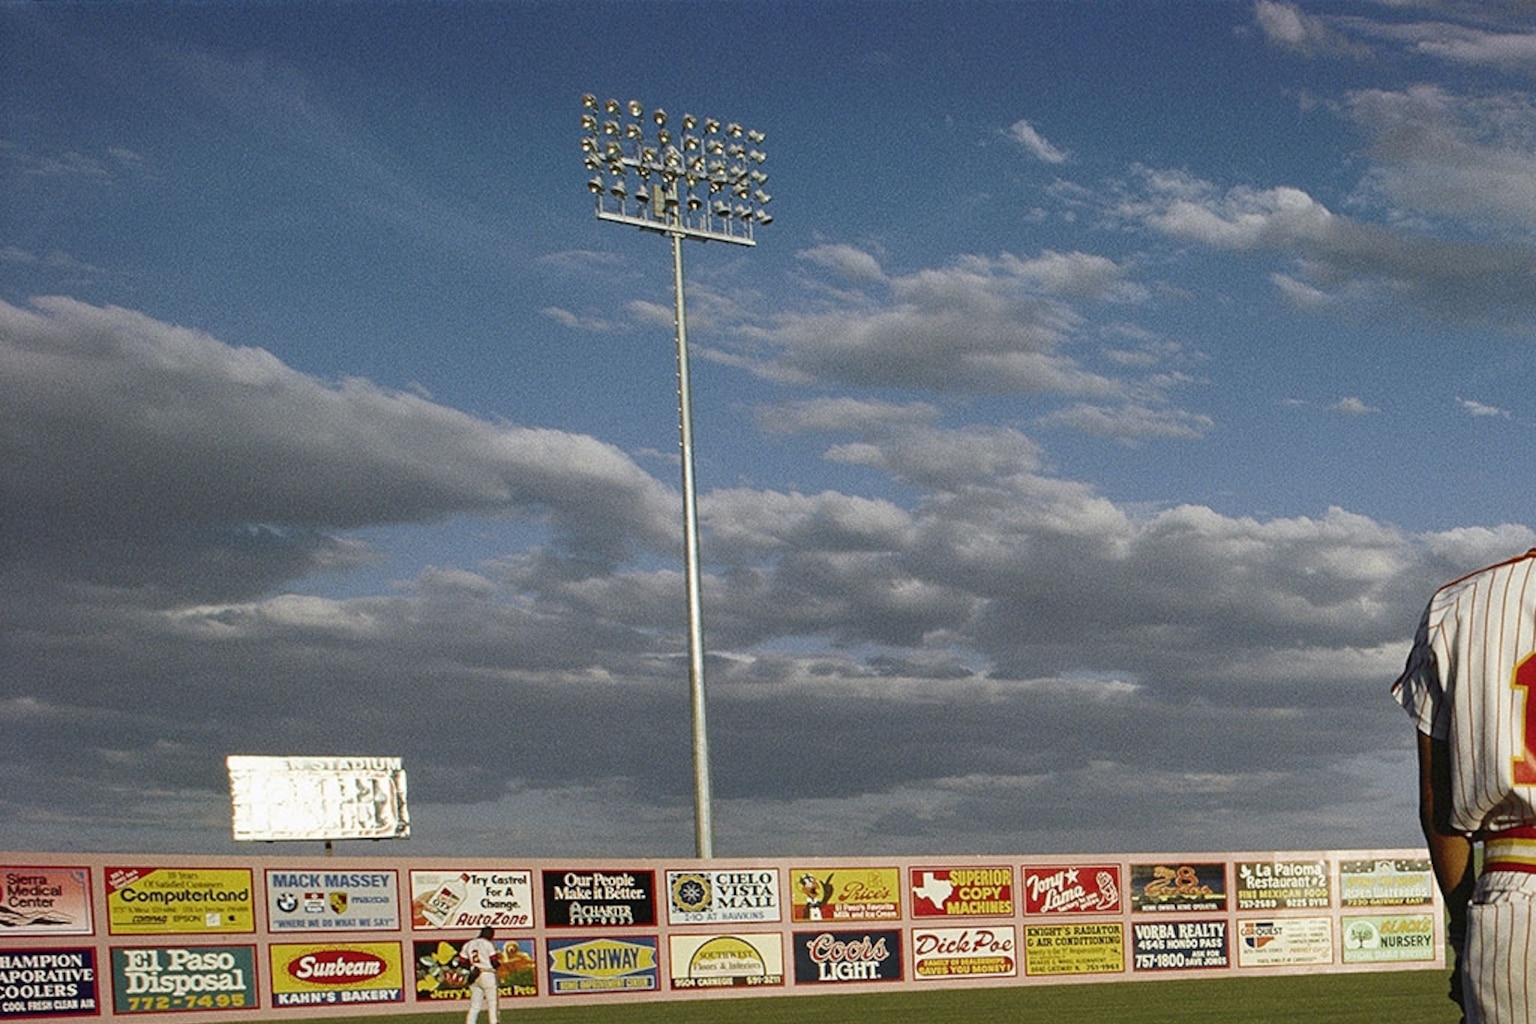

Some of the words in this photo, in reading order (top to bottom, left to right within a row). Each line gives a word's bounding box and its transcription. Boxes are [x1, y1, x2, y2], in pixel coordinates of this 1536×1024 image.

[311, 759, 400, 771] STADIUM
[1255, 864, 1272, 877] La
[1274, 863, 1323, 876] Paloma
[6, 873, 47, 885] Sierra
[272, 874, 322, 888] MACK
[324, 874, 390, 888] MASSEY
[471, 874, 488, 887] Try
[491, 875, 527, 885] Castrol
[563, 872, 593, 888] Our
[593, 872, 636, 890] People
[715, 873, 772, 886] CIELO
[949, 869, 1012, 887] SUPERIOR
[1246, 876, 1310, 889] Restaurant
[7, 885, 62, 897] Medical
[486, 887, 502, 897] For
[505, 886, 514, 897] A
[553, 886, 592, 900] Make
[593, 886, 602, 900] it
[605, 886, 646, 900] Better.
[715, 884, 773, 897] VISTA
[838, 881, 891, 901] Price's
[958, 886, 1003, 900] COPY
[1026, 871, 1064, 902] Tony
[1259, 889, 1301, 899] MEXICAN
[1304, 888, 1328, 898] FOOD
[8, 896, 55, 908] Center
[480, 899, 521, 911] Change.
[717, 896, 776, 908] MALL
[1041, 885, 1085, 913] Lama
[947, 899, 1012, 915] MACHINES
[455, 912, 528, 926] AutoZone
[1027, 927, 1072, 937] KNIGHT'S
[1073, 925, 1121, 936] RADIATOR
[1134, 924, 1177, 940] VORBA
[1178, 922, 1226, 939] REALTY
[806, 933, 890, 963] Coors
[916, 930, 971, 955] Dick
[971, 930, 1013, 953] Poe
[1036, 938, 1053, 947] AIR
[1055, 936, 1121, 947] CONDITIONING
[1166, 938, 1198, 949] HONDO
[1200, 937, 1223, 948] PASS
[1380, 935, 1431, 948] NURSERY
[0, 953, 83, 969] HAMPION
[124, 950, 163, 972] El
[167, 949, 235, 972] Paso
[471, 949, 480, 963] 2
[565, 947, 639, 970] CASHWAY
[1135, 953, 1185, 968] 757-1800
[296, 956, 381, 979] Sunbeam
[818, 961, 882, 981] LIGHT.
[950, 965, 971, 974] YOU
[0, 968, 94, 984] APORATIVE
[126, 968, 246, 996] Disposal
[278, 991, 336, 1005] KAHN'S
[341, 988, 399, 1002] BAKERY
[514, 985, 537, 996] Pets
[2, 1001, 27, 1012] COOL
[27, 1000, 53, 1011] FRESH
[80, 998, 95, 1010] AIR
[128, 993, 245, 1011] 772-7495
